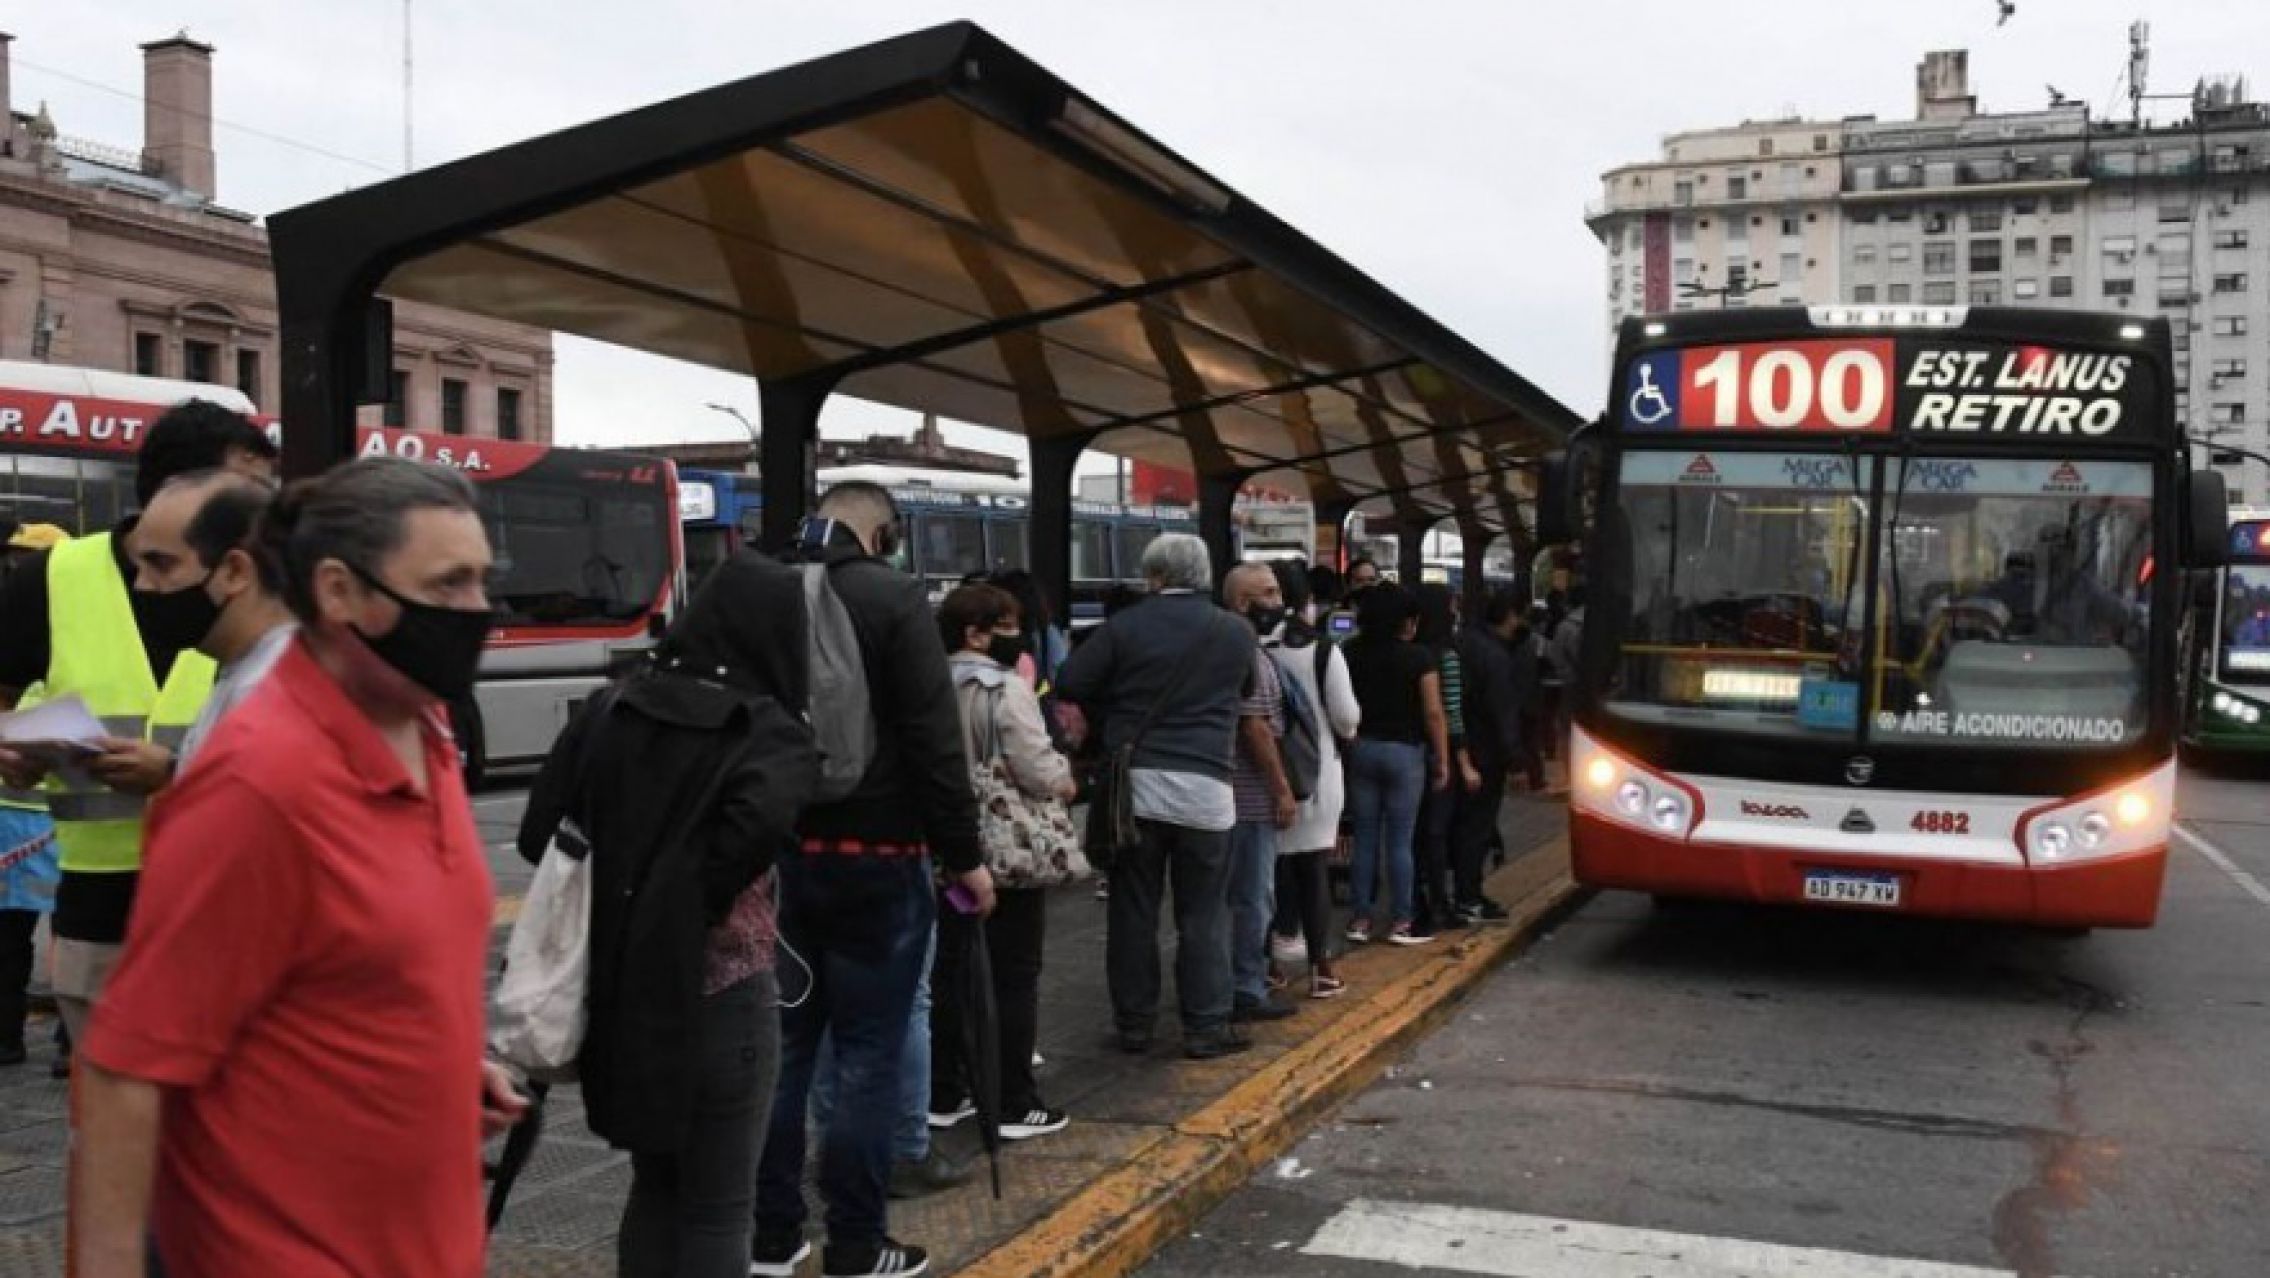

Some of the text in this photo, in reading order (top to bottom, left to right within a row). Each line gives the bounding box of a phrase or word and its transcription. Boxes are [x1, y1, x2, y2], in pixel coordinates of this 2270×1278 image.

[1693, 348, 1885, 428] 100
[1906, 350, 2131, 391] EST. LANUS
[1910, 394, 2122, 435] RETIRO
[1900, 710, 2125, 742] AIRE ACONDICIONADO
[1910, 809, 1971, 834] 4882
